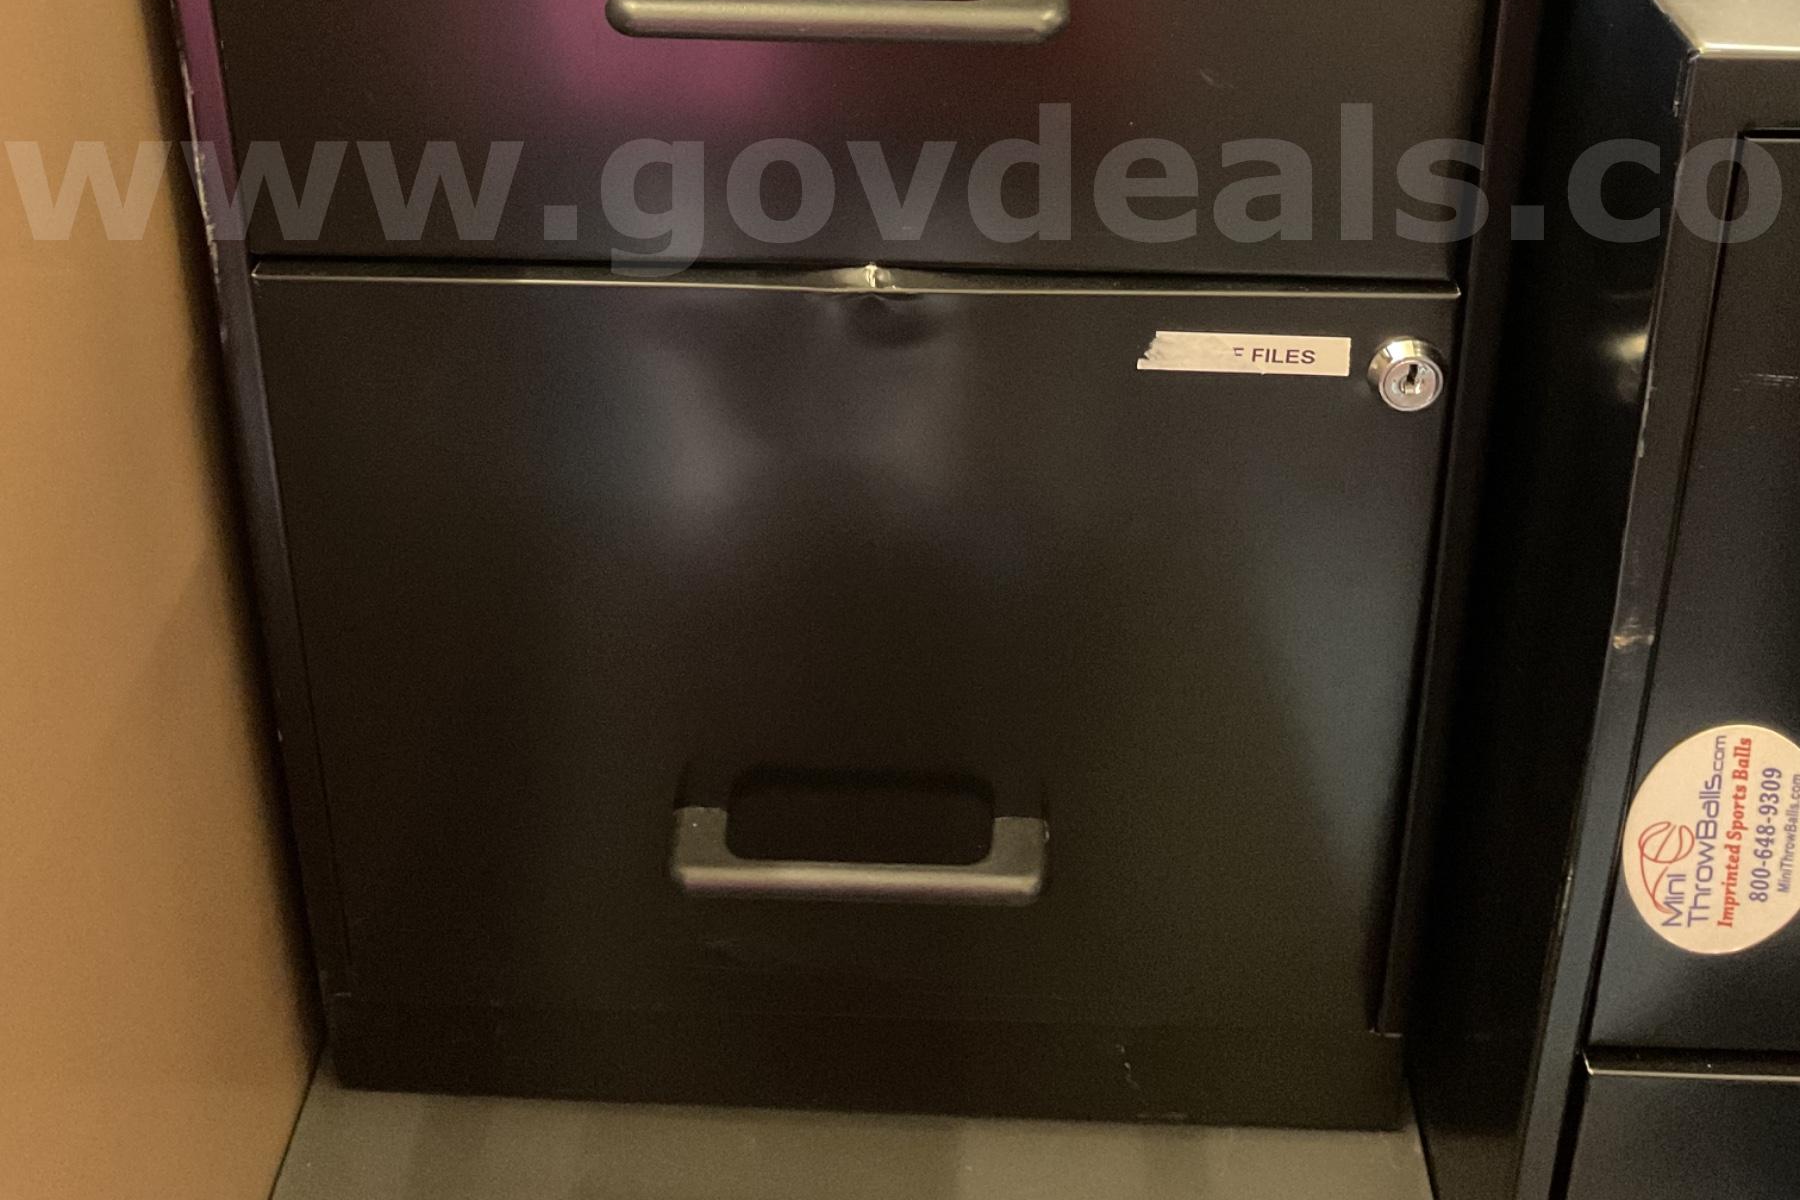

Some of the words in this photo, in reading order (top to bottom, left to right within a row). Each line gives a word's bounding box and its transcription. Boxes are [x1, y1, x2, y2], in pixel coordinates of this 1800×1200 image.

[1251, 347, 1317, 365] FILES
[1732, 737, 1753, 782] Balls
[1687, 735, 1727, 928] ThrowBalls.com
[1726, 784, 1748, 842] Sports
[1748, 767, 1783, 902] 800-648-9309
[1777, 773, 1800, 894] MiniThrowBalls.com
[1661, 873, 1688, 928] Mini
[1717, 843, 1741, 929] Imprinted
